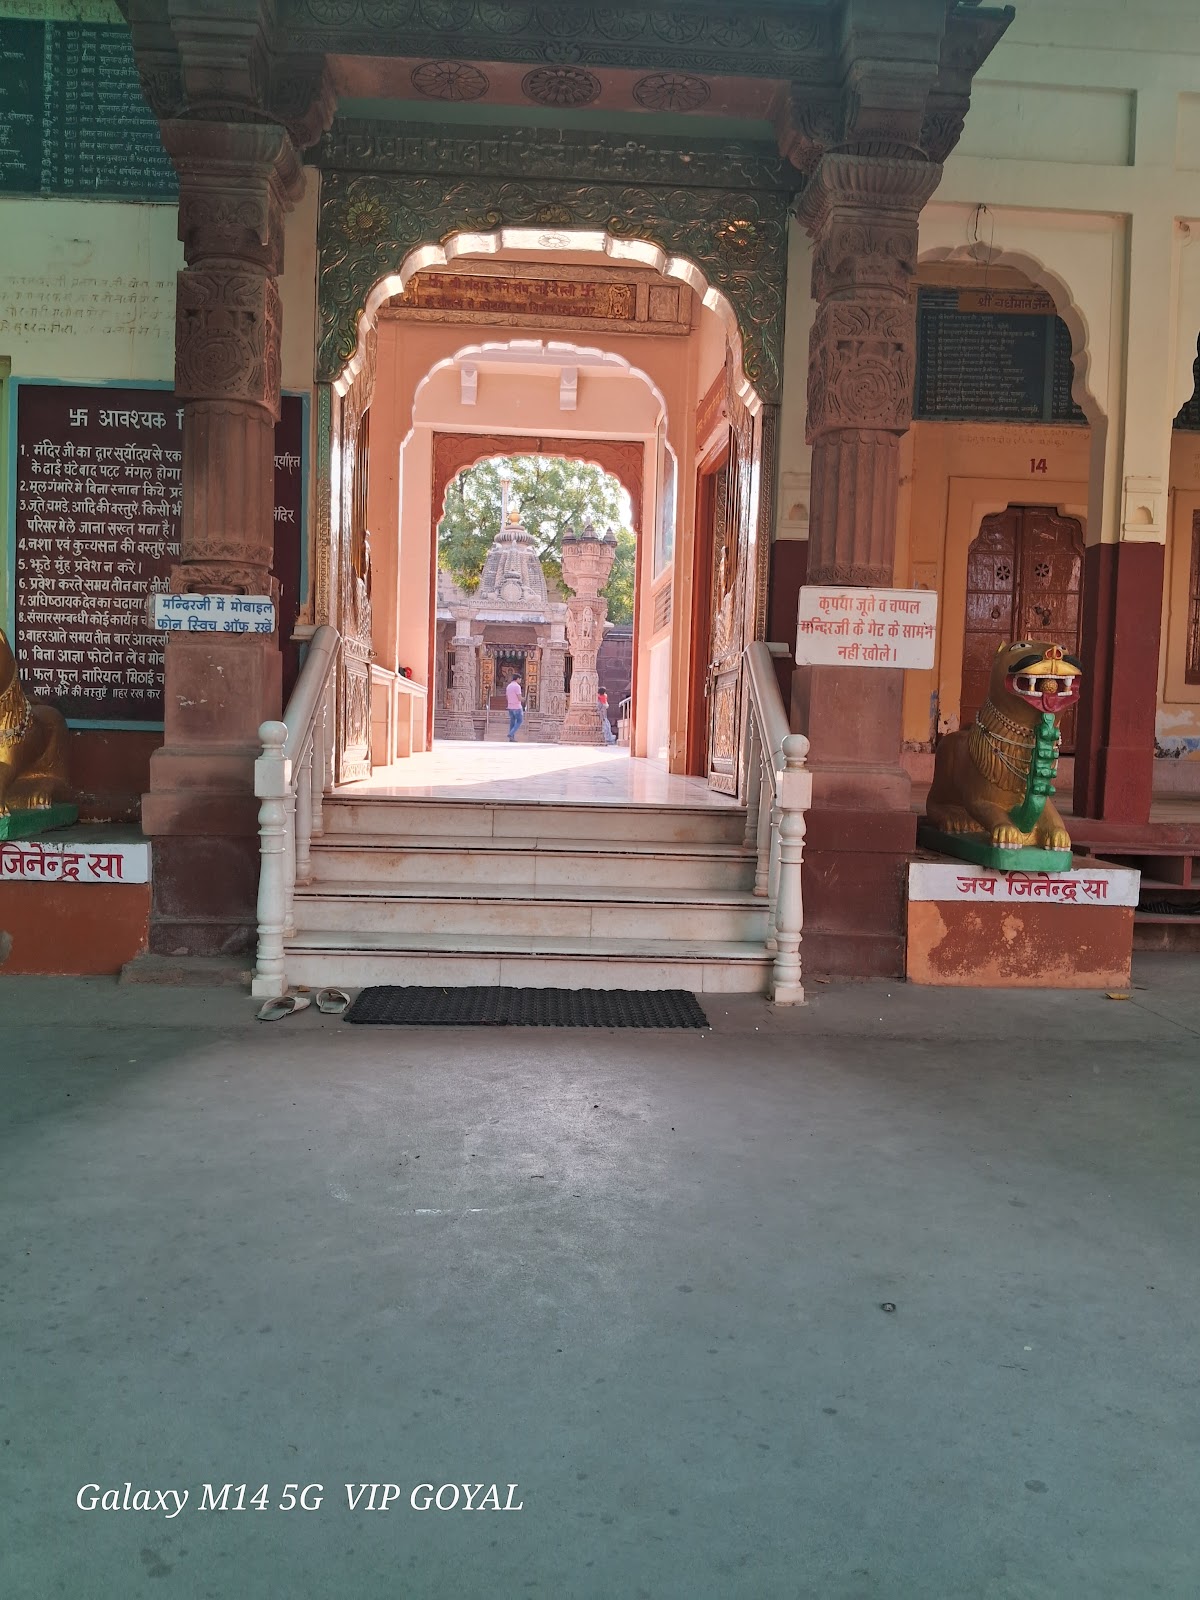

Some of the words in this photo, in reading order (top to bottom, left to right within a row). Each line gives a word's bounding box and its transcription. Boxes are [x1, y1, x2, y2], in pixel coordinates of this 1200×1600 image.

[98, 409, 166, 430] आवश्यक
[33, 439, 61, 458] मंदिर
[63, 442, 76, 458] जी
[77, 447, 92, 459] का
[95, 447, 113, 463] द्वार
[114, 442, 152, 464] सूर्योदय
[152, 444, 163, 461] से
[164, 450, 182, 462] एक
[31, 459, 42, 474] के
[43, 459, 62, 477] ढाई
[64, 460, 77, 476] घंटे
[79, 464, 97, 478] बाद
[124, 465, 152, 480] मंगल
[156, 463, 182, 481] होगा
[1029, 458, 1048, 473] 14
[29, 480, 46, 496] मूल
[47, 478, 74, 494] गंभारे
[84, 478, 110, 495] बिना
[111, 484, 141, 497] स्नान
[142, 480, 166, 498] किये
[72, 497, 96, 516] आदि
[96, 498, 110, 514] की
[142, 498, 171, 517] किसी
[27, 516, 58, 534] परिसर
[66, 517, 76, 534] ले
[79, 521, 106, 535] जाना
[107, 522, 135, 536] सख्त
[137, 523, 161, 536] मना
[28, 538, 52, 552] नशा
[55, 537, 72, 552] एवं
[73, 540, 118, 557] कुव्यसन
[120, 538, 136, 553] की
[74, 557, 101, 573] प्रवेश
[104, 562, 113, 573] न
[29, 574, 56, 591] प्रवेश
[58, 575, 84, 592] करते
[84, 579, 111, 592] समय
[111, 576, 132, 593] तीन
[132, 580, 148, 594] बार
[27, 590, 82, 609] अधिष्ठायक
[82, 592, 98, 609] देव
[98, 598, 111, 609] का
[216, 597, 225, 612] में
[230, 598, 273, 615] मोबाइल
[819, 597, 854, 614] कृपया
[856, 595, 877, 616] जूते
[879, 599, 887, 612] व
[890, 599, 921, 614] चप्पल
[26, 609, 53, 625] संसार
[53, 609, 89, 626] सम्बन्धी
[89, 611, 110, 627] कोई
[109, 611, 131, 626] कार्य
[157, 614, 183, 630] फोन
[188, 615, 217, 631] स्विच
[223, 618, 250, 632] ऑफ
[254, 618, 273, 632] रखें
[853, 618, 866, 636] के
[868, 619, 886, 637] गेट
[888, 620, 901, 638] के
[48, 627, 68, 644] आते
[68, 632, 94, 645] समय
[94, 629, 111, 645] तीन
[113, 633, 131, 647] बार
[32, 644, 55, 662] बिना
[57, 649, 85, 665] आज्ञा
[87, 648, 113, 664] फोटो
[114, 652, 124, 664] न
[137, 652, 146, 665] व
[126, 667, 154, 687] मिठाई
[71, 684, 83, 698] की
[130, 689, 144, 700] रख
[146, 689, 162, 701] कर
[0, 842, 85, 881] जिनेन्द्र
[88, 854, 124, 880] सा
[957, 876, 997, 896] जय
[1005, 871, 1081, 902] जिनेन्द्र
[1081, 879, 1109, 900] सा
